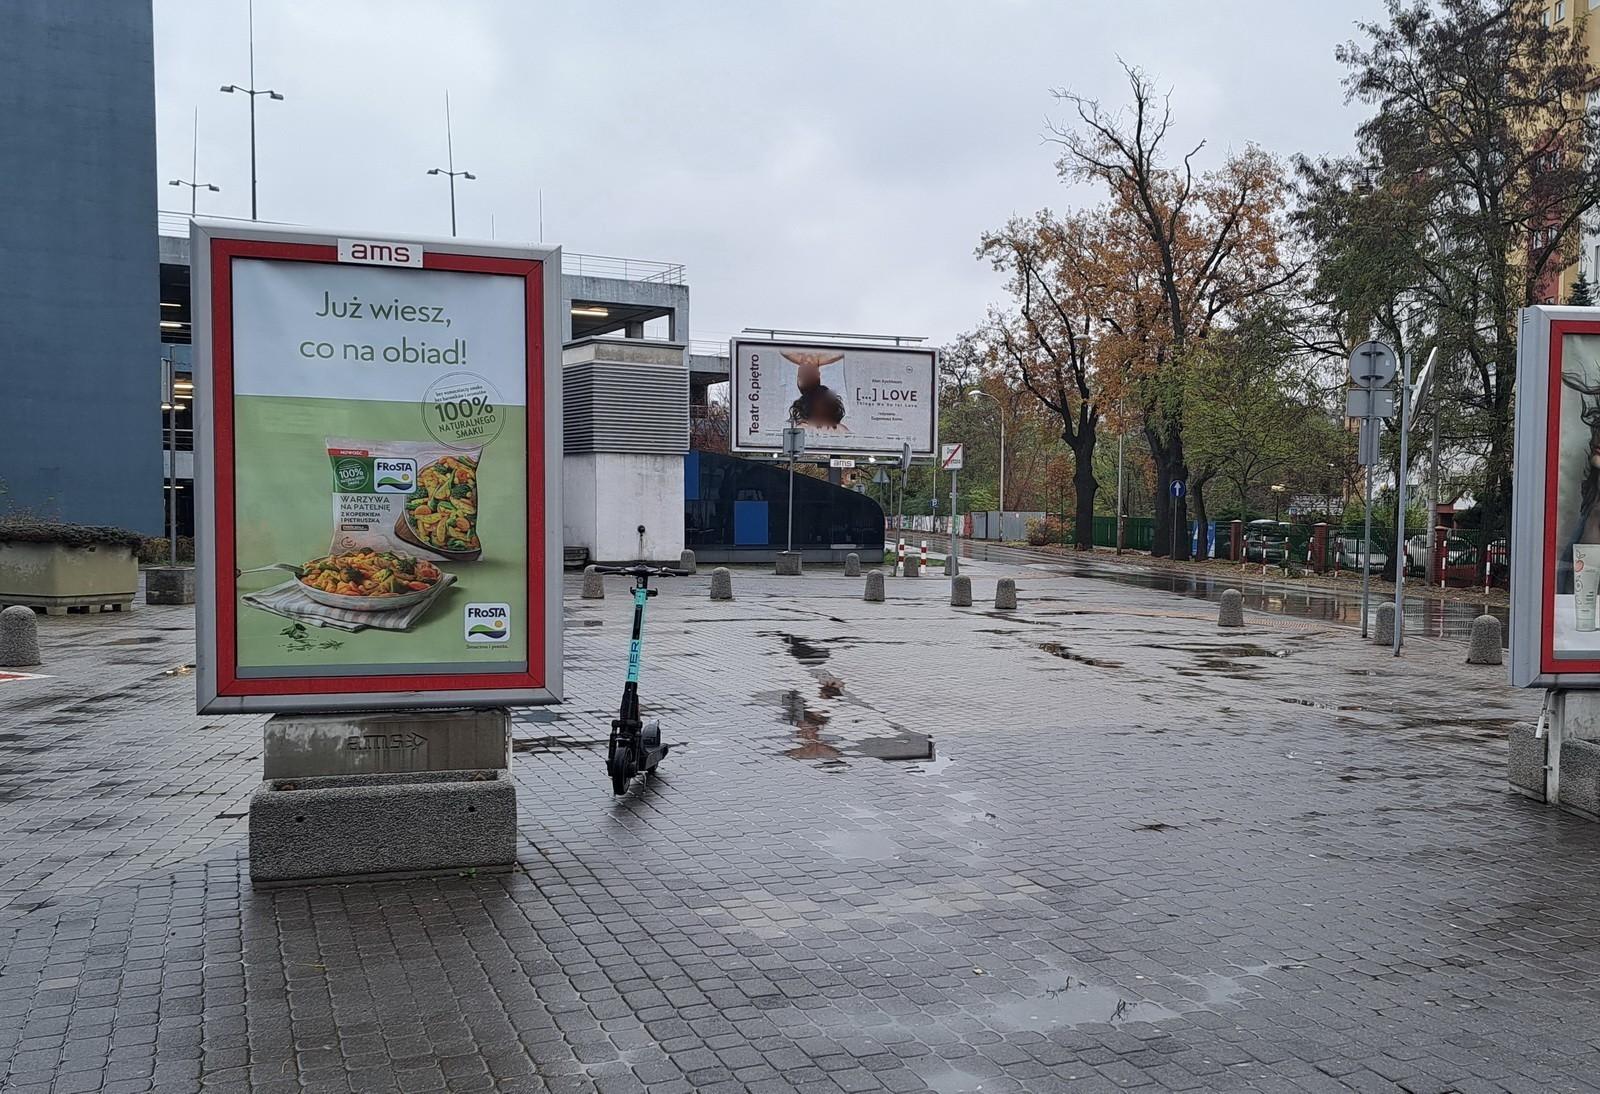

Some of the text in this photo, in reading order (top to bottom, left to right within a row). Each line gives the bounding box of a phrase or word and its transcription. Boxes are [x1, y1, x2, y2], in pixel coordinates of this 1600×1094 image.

[350, 243, 411, 263] ams
[315, 290, 452, 328] Już wiesz,
[299, 336, 468, 365] co na obiad!
[882, 389, 918, 402] LOVE
[434, 394, 494, 422] 100%
[438, 414, 496, 433] NATURALNEGO
[748, 403, 760, 436] Teatr
[456, 425, 484, 439] SMAKU
[833, 459, 853, 467] ams
[338, 467, 364, 479] 100%
[340, 495, 390, 503] WARZYWA
[353, 503, 391, 512] PATELNIĘ
[627, 641, 640, 679] TIER
